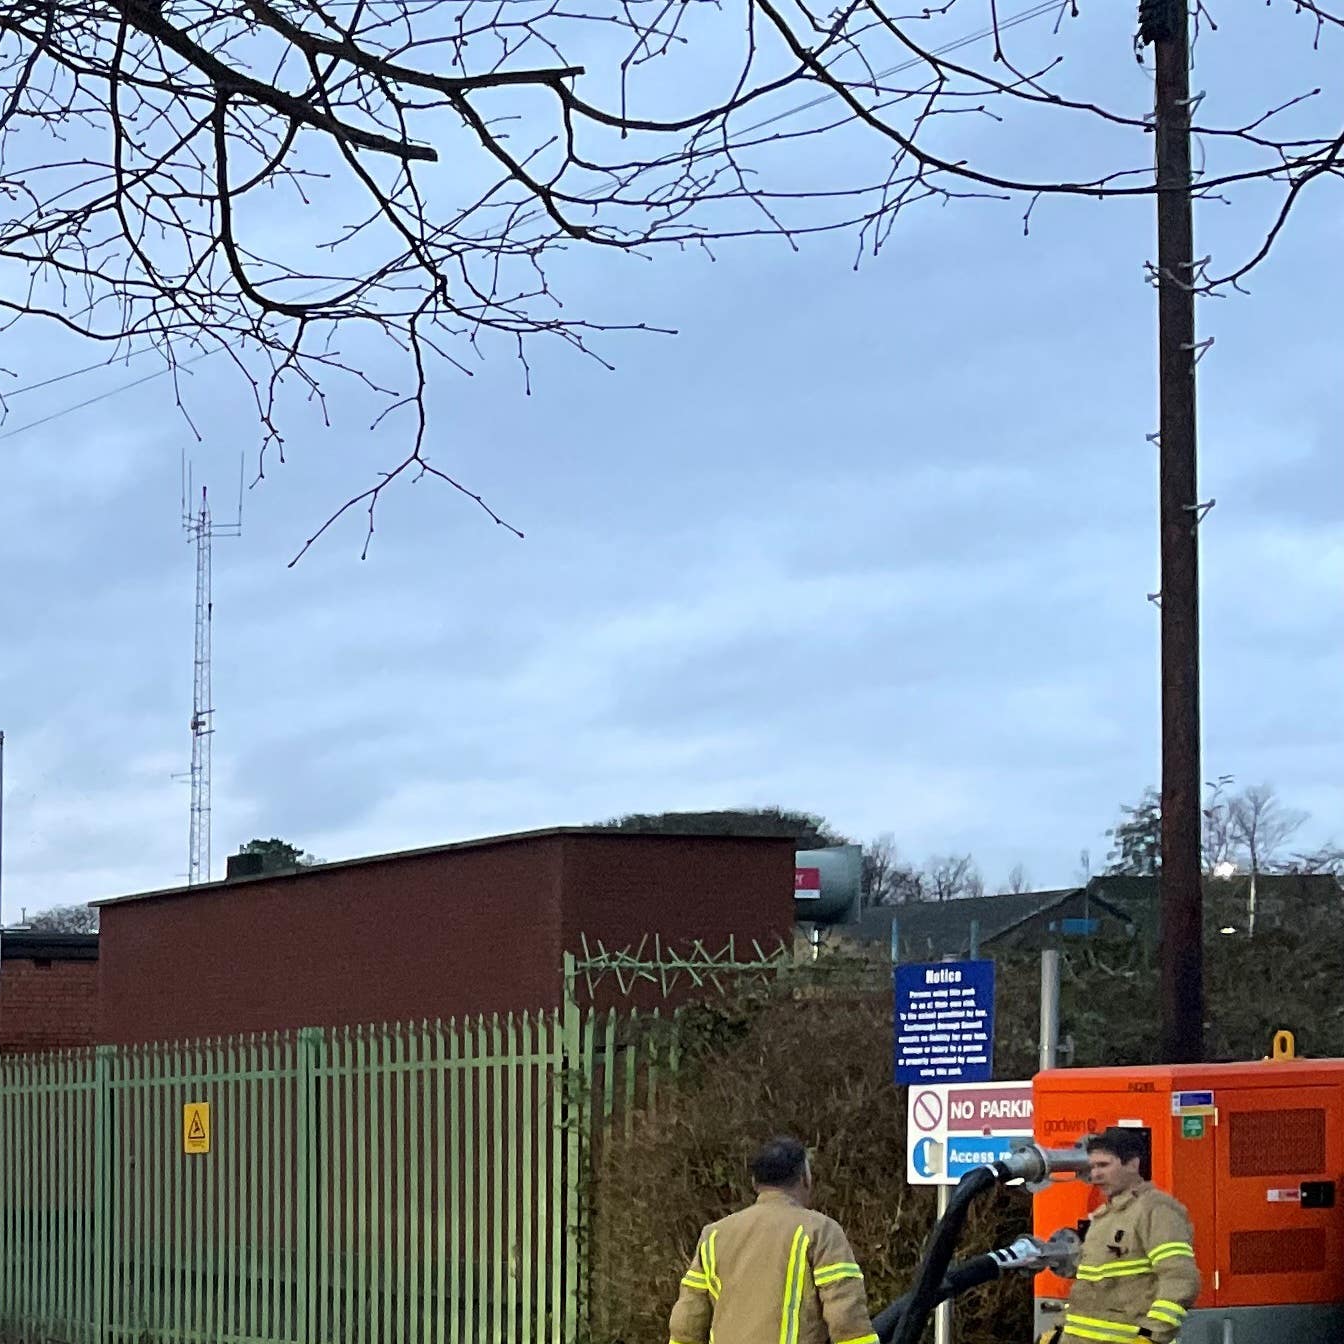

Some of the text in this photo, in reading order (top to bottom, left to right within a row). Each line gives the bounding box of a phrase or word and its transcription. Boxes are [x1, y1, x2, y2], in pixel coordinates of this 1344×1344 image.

[925, 968, 962, 984] Notice
[950, 1099, 1034, 1119] NO PARKIN
[950, 1148, 995, 1164] Access
